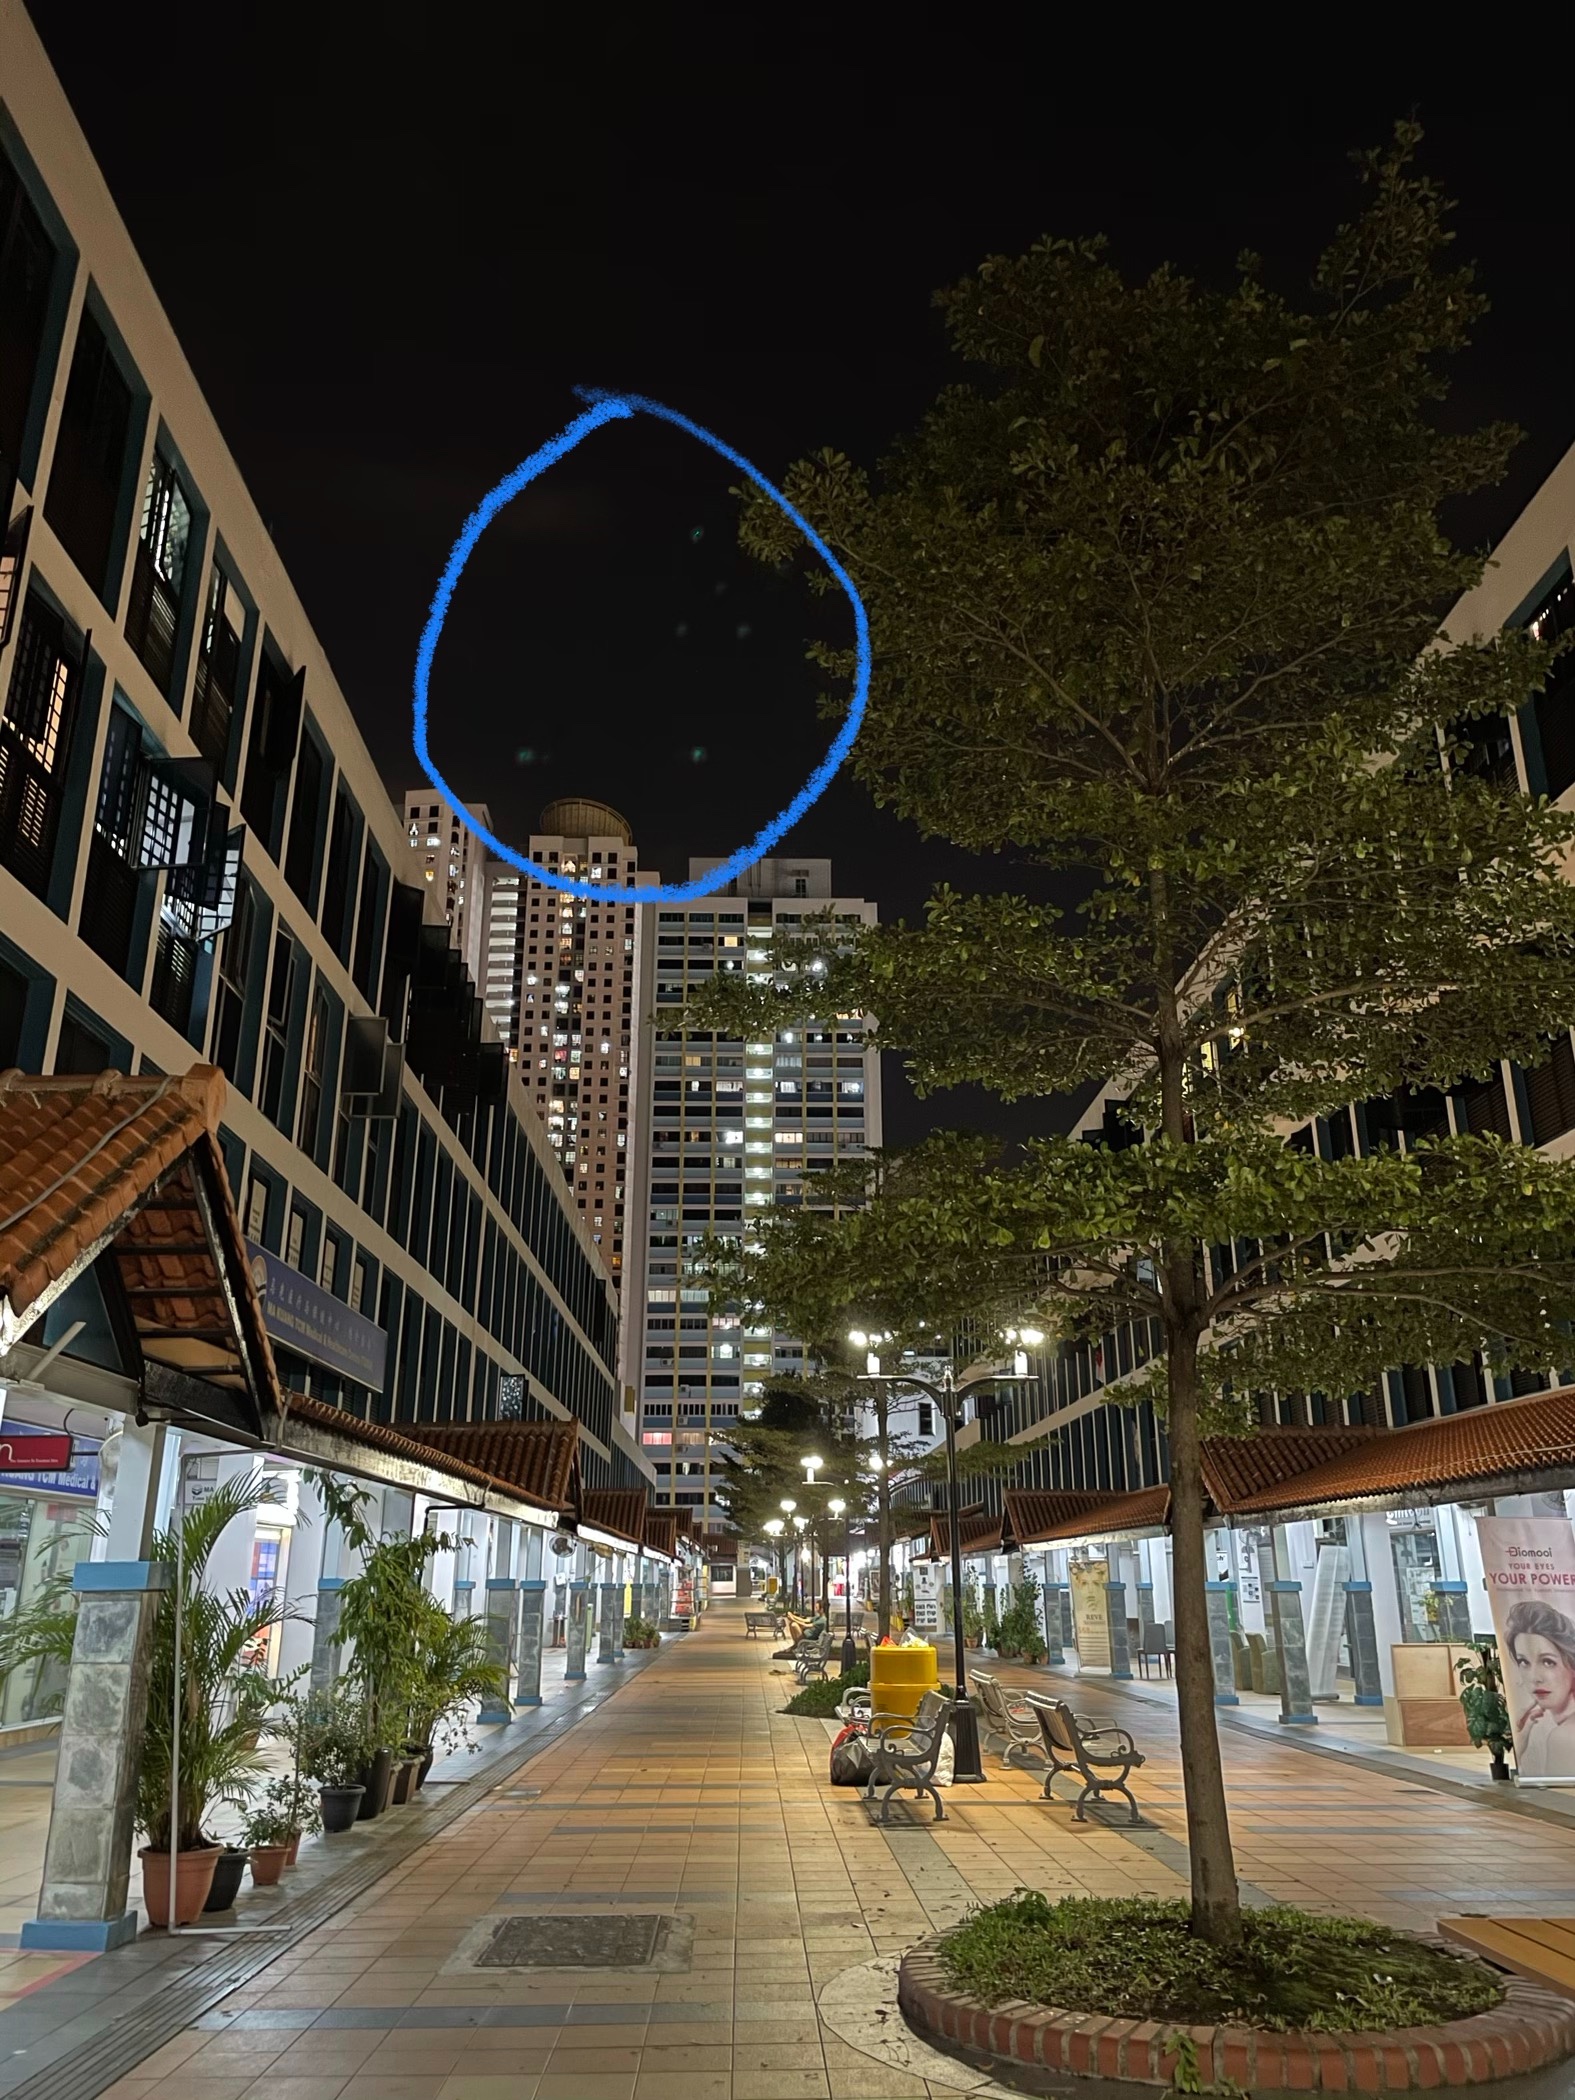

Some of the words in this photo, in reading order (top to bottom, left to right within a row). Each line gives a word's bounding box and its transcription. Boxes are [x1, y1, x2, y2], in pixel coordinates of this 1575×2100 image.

[38, 1472, 56, 1484] TCM
[58, 1472, 88, 1490] Medical
[1505, 1546, 1552, 1557] Biomooi
[1489, 1573, 1527, 1585] YOUR
[1531, 1573, 1575, 1586] POWER
